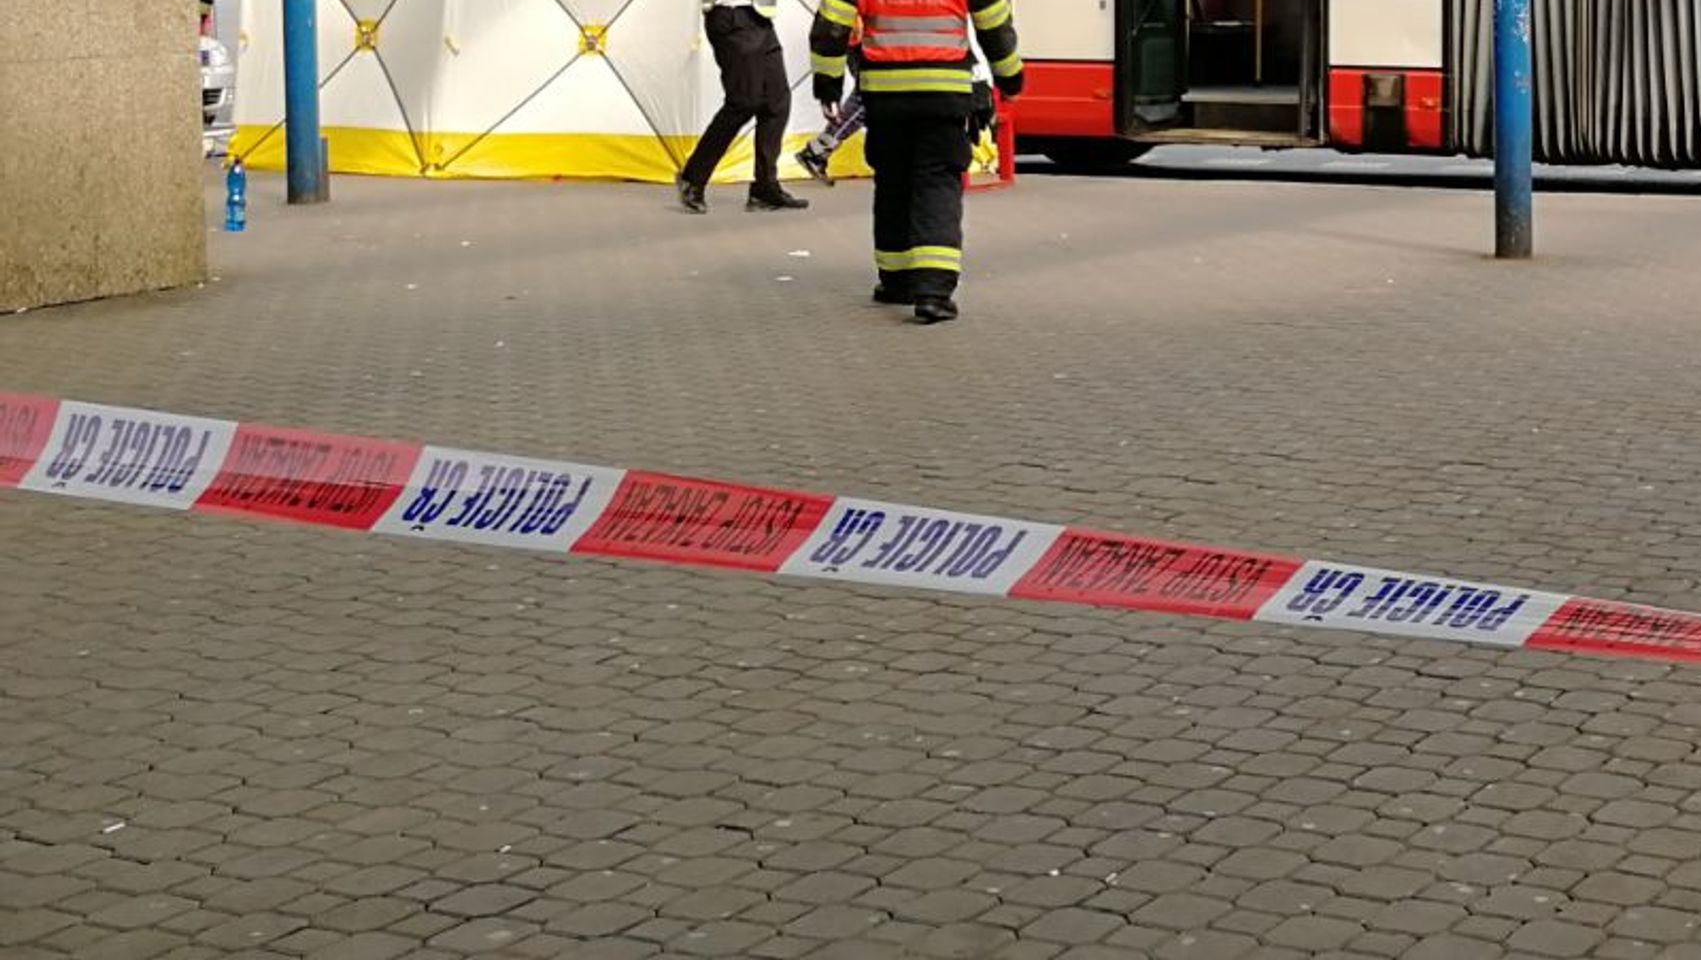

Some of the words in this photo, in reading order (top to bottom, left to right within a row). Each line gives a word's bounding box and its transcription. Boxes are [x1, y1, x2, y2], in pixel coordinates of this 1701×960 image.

[45, 412, 102, 488] ČR
[84, 418, 212, 494] POLICIE
[401, 458, 470, 532] ČR
[446, 464, 593, 535] POLICIE
[809, 507, 887, 573] ČR
[860, 514, 1029, 580] POLICIE
[1285, 568, 1366, 622] ČR
[1345, 576, 1532, 632] POLICIE
